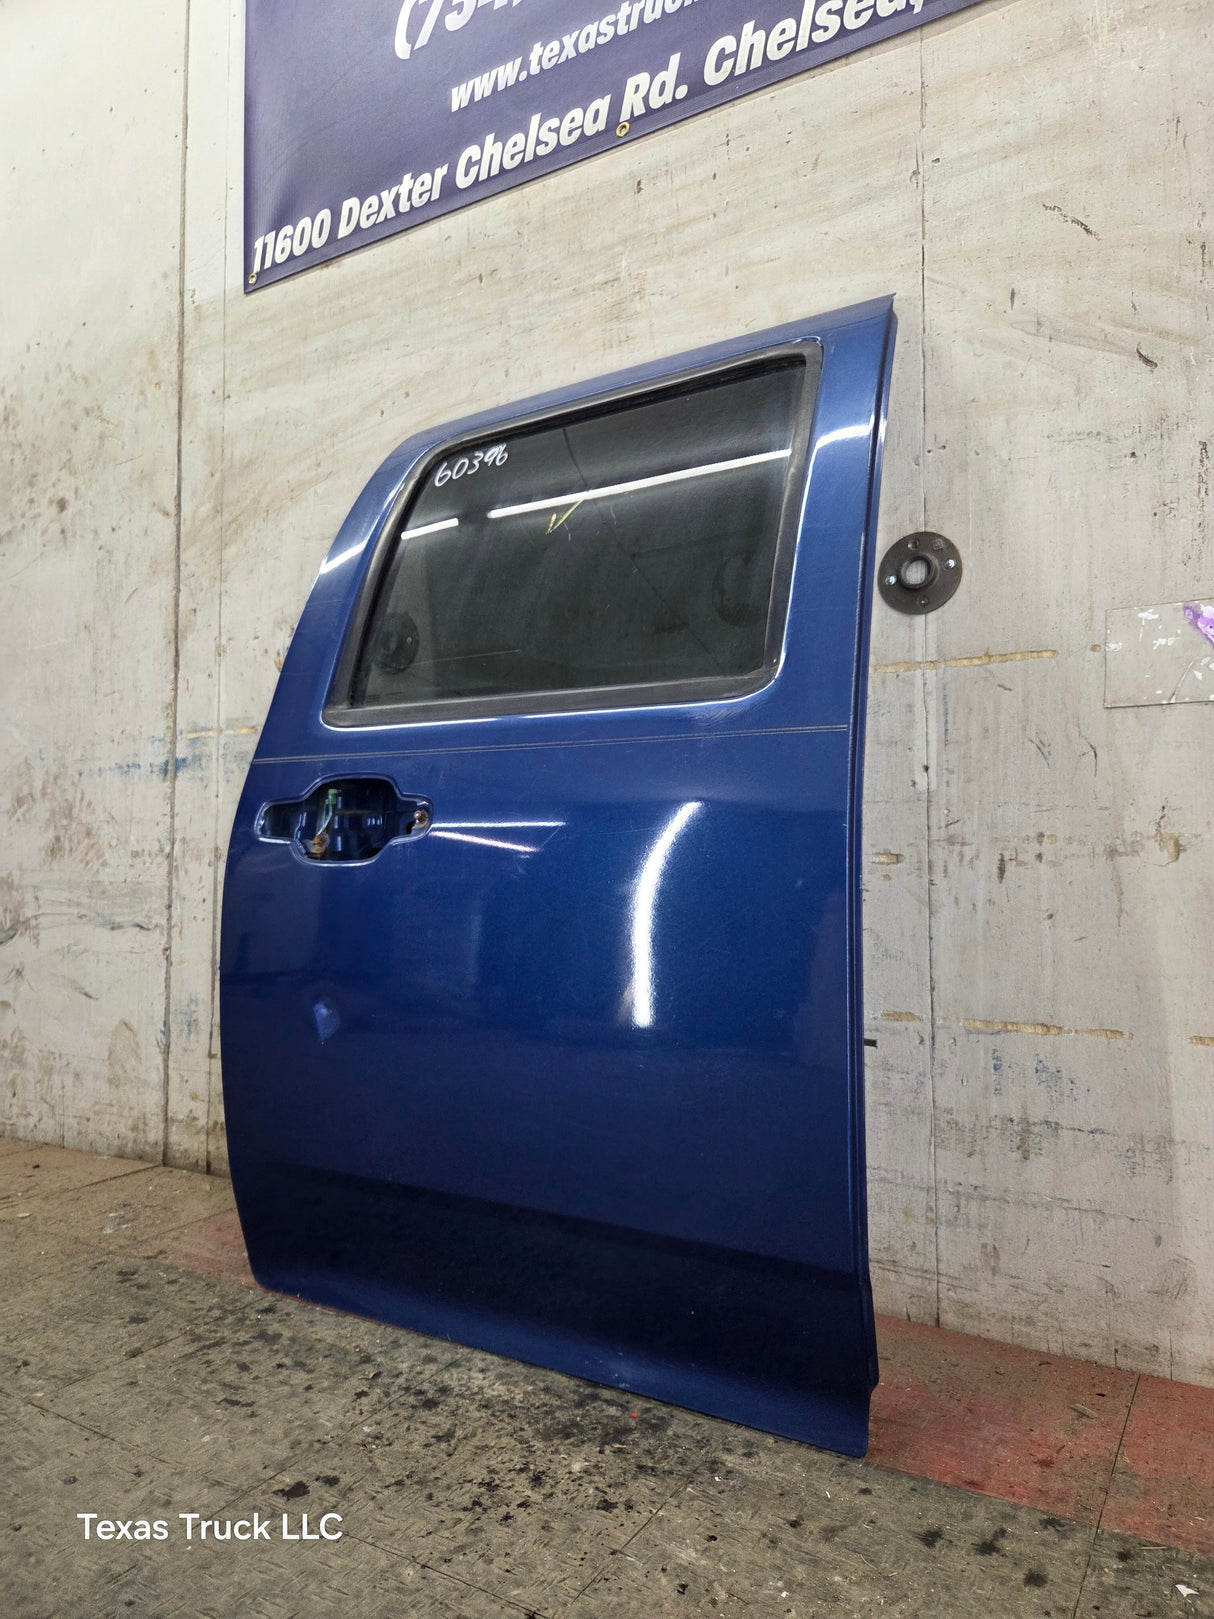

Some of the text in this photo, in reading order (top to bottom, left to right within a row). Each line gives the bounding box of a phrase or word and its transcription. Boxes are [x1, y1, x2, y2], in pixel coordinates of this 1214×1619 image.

[451, 0, 702, 112] www.texastru
[253, 208, 332, 273] 11600
[337, 163, 449, 240] Dexter
[455, 93, 612, 190] Chelsea
[619, 52, 689, 123] Rd.
[434, 442, 509, 487] 60396
